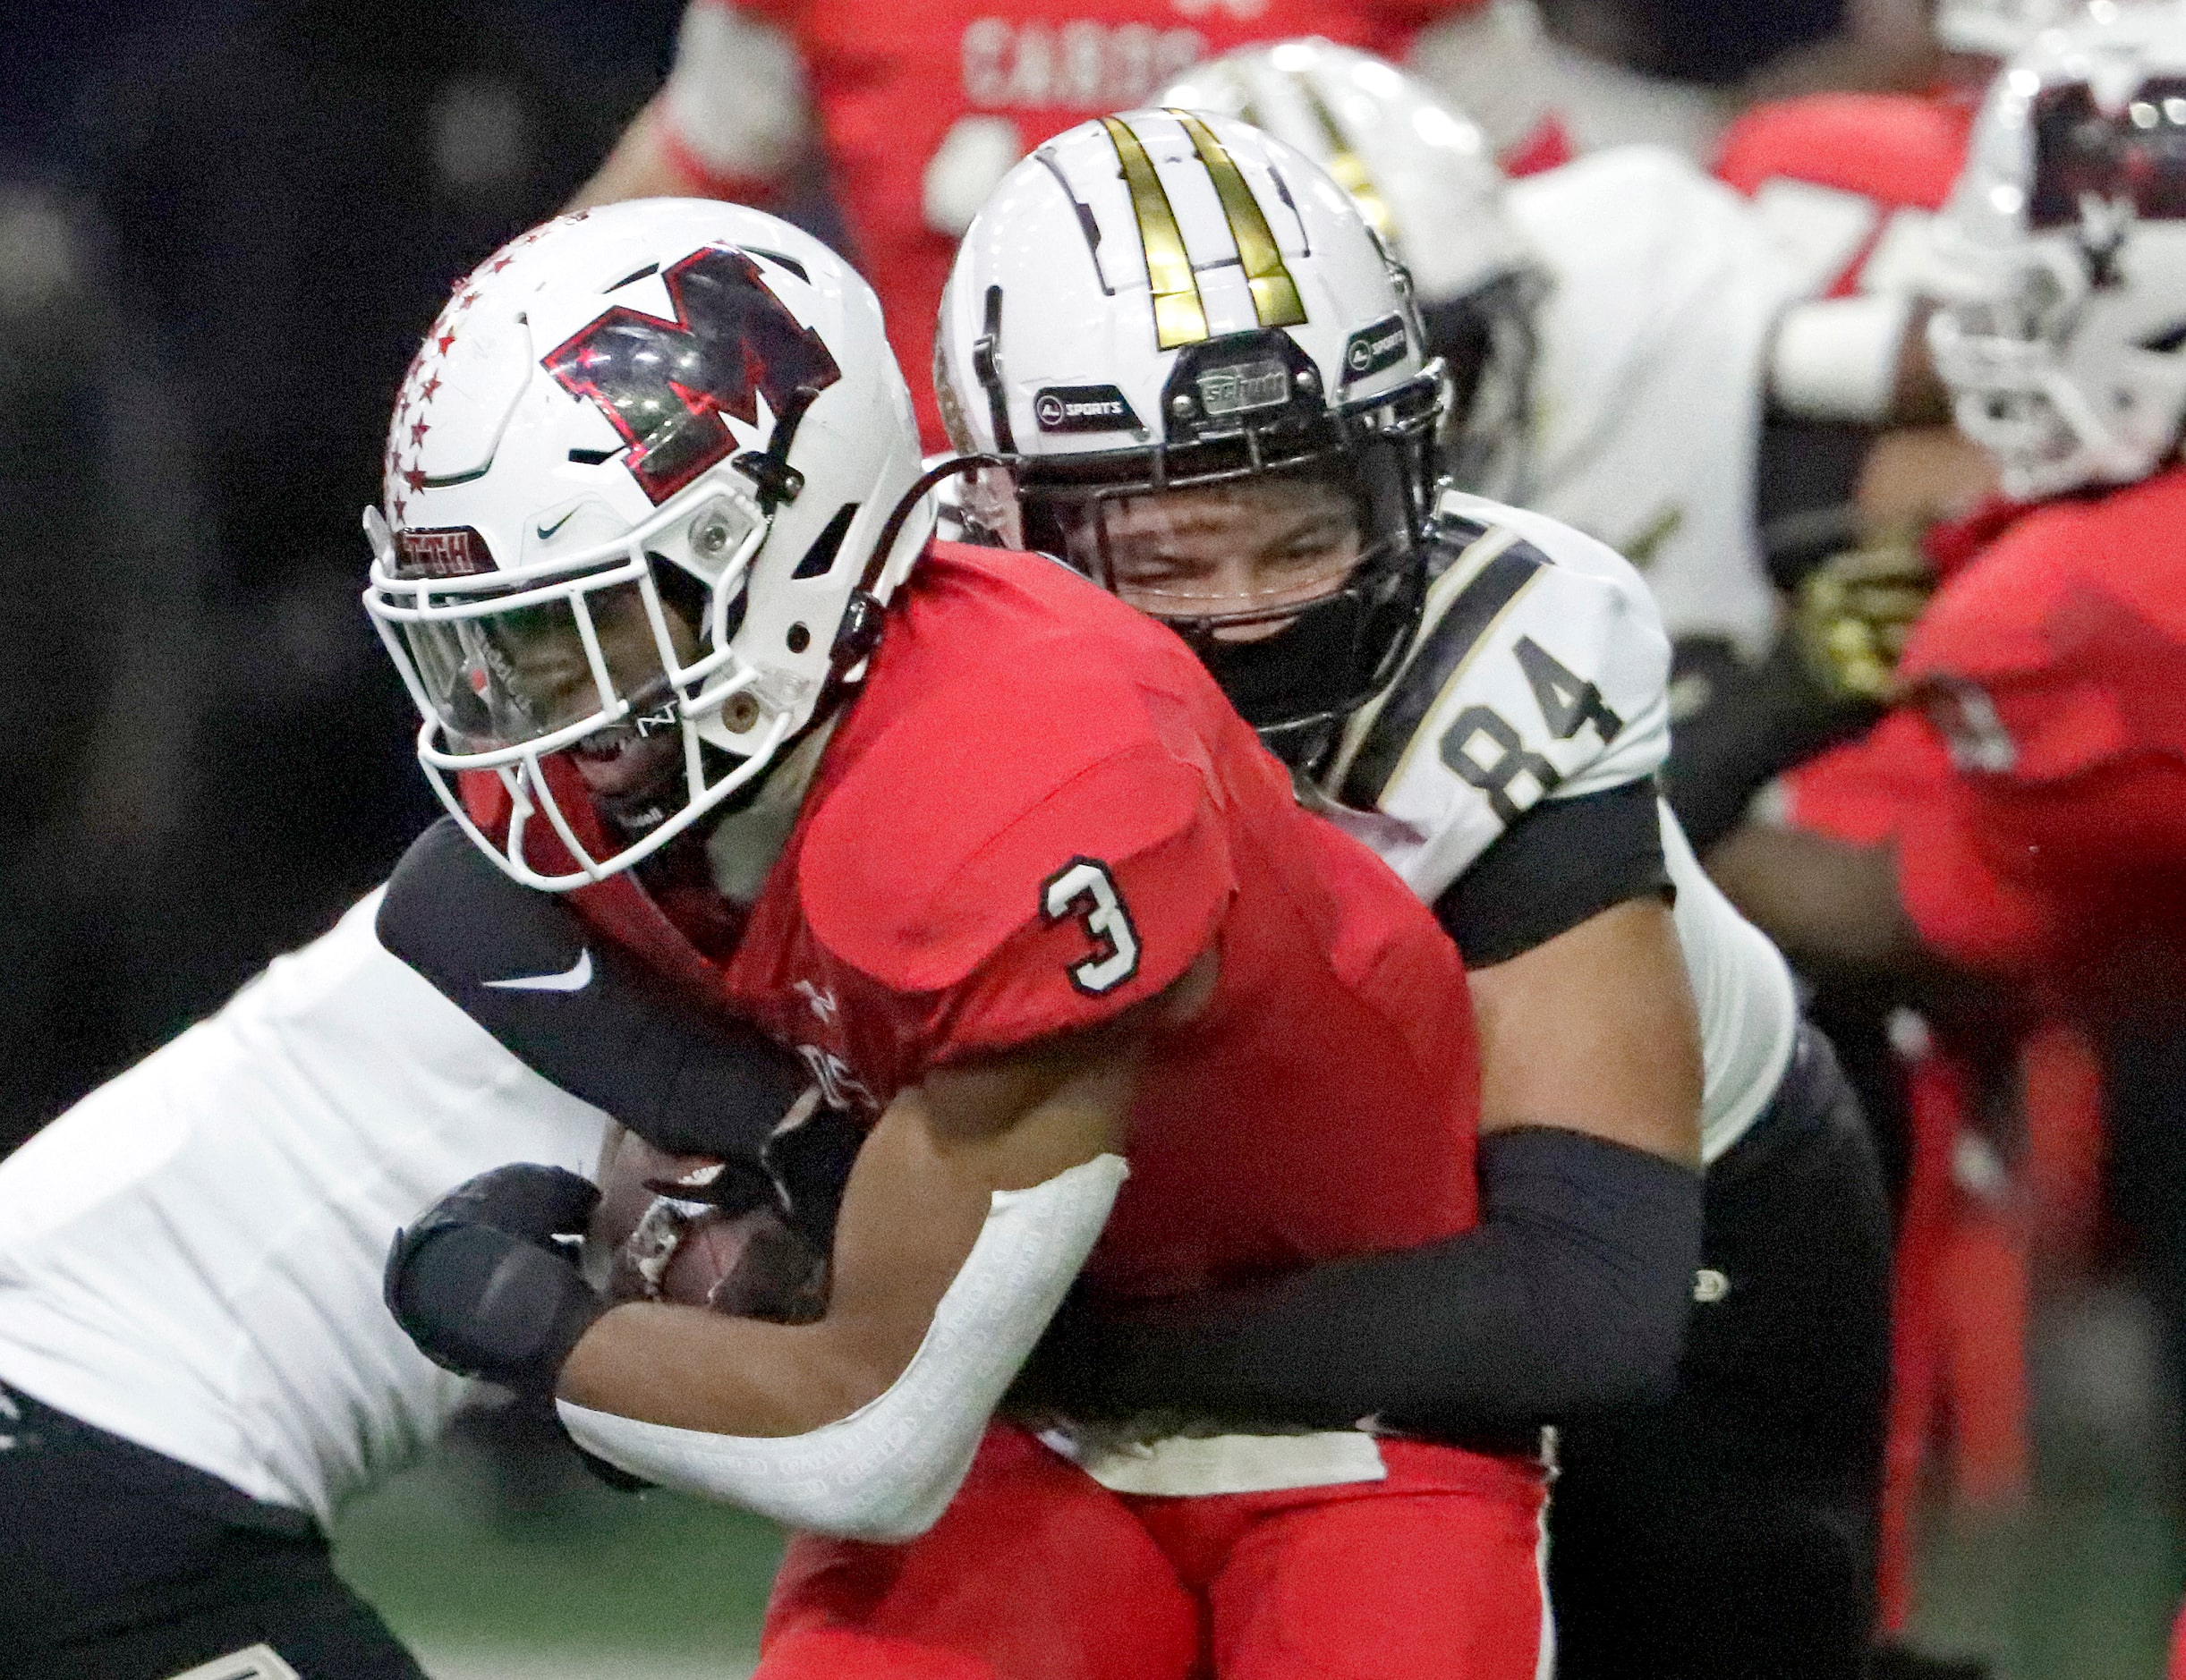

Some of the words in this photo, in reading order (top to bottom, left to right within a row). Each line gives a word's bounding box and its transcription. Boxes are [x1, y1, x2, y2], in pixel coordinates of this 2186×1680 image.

[1065, 401, 1124, 417] SPORTS
[1438, 633, 1623, 828] 84
[1040, 855, 1142, 998] 3
